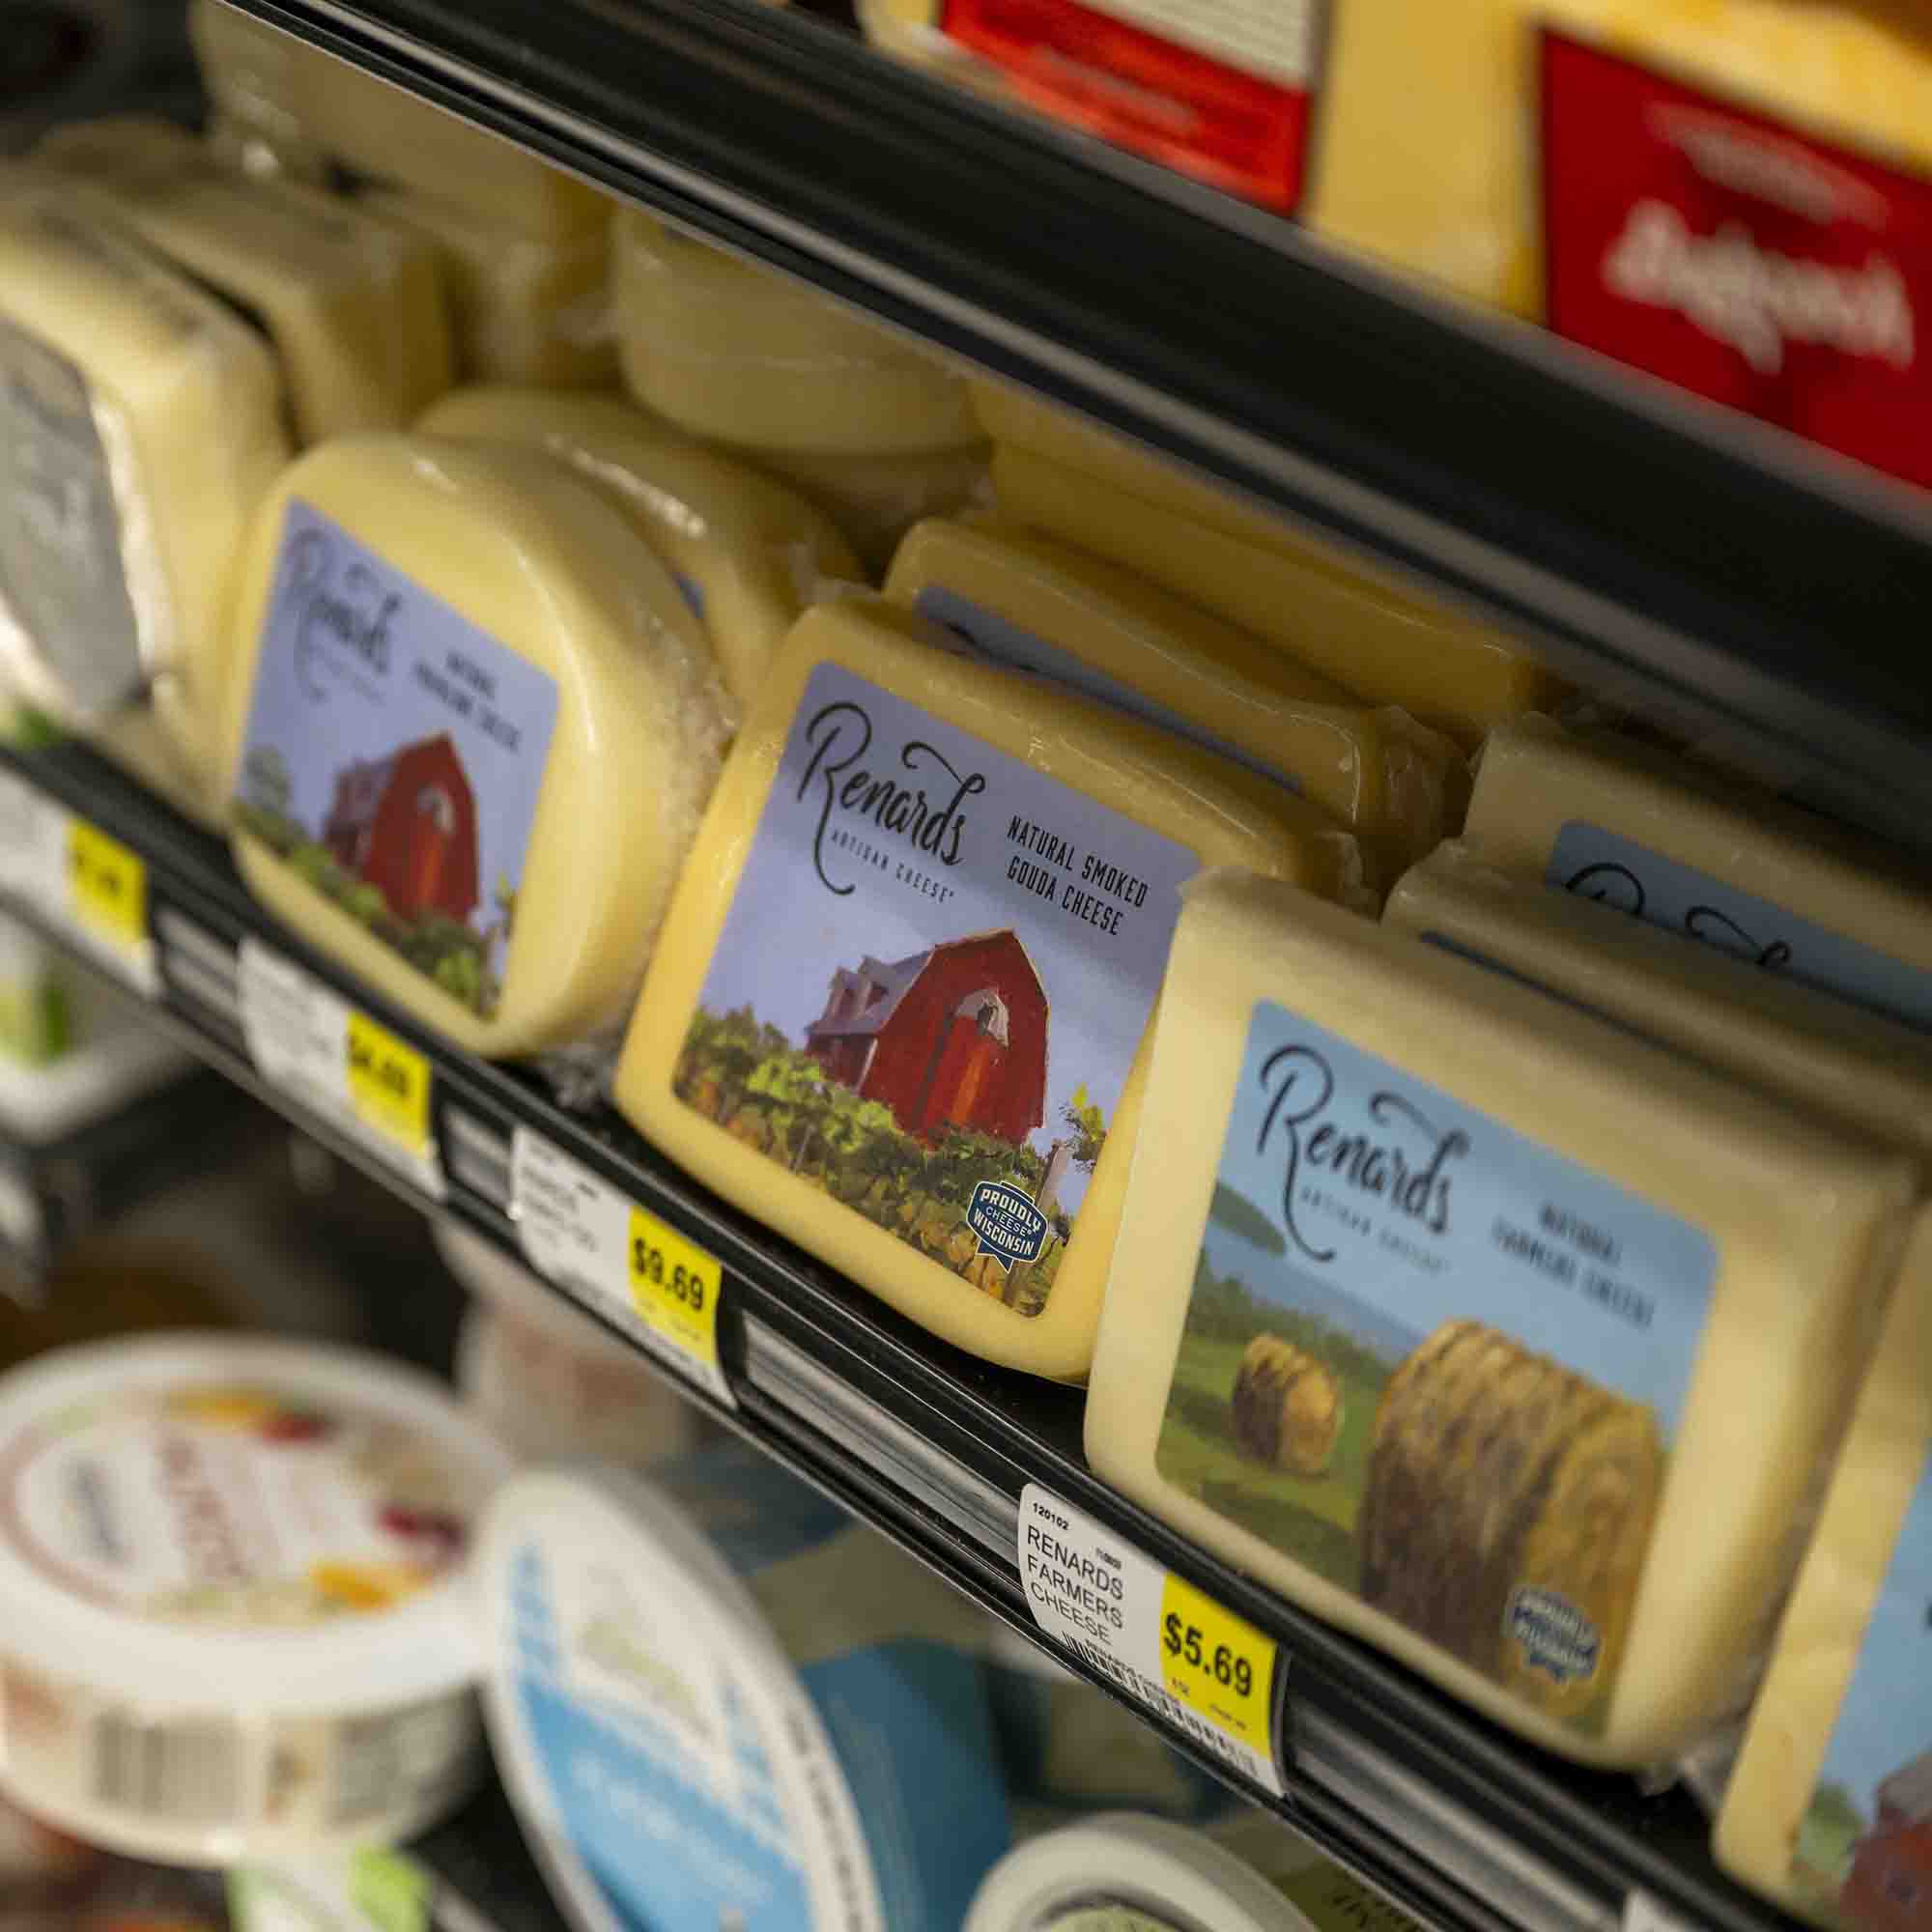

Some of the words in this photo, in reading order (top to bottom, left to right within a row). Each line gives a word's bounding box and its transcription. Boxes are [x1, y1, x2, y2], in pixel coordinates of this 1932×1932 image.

[798, 701, 986, 895] Renards
[1006, 814, 1074, 871] NATURAL
[1081, 856, 1150, 908] SMOKED
[1007, 855, 1057, 901] GOUDA
[1062, 885, 1124, 936] CHEESE
[1257, 1042, 1470, 1264] Renards
[973, 1208, 1035, 1256] WISCONSIN
[980, 1188, 1042, 1234] PROUDLY
[633, 1236, 704, 1312] $9.69
[1032, 1501, 1069, 1531] 120102
[1026, 1523, 1123, 1601] RENARDS
[1026, 1552, 1123, 1630] FARMERS
[1030, 1580, 1112, 1646] CHEESE
[1163, 1611, 1253, 1698] $5.69
